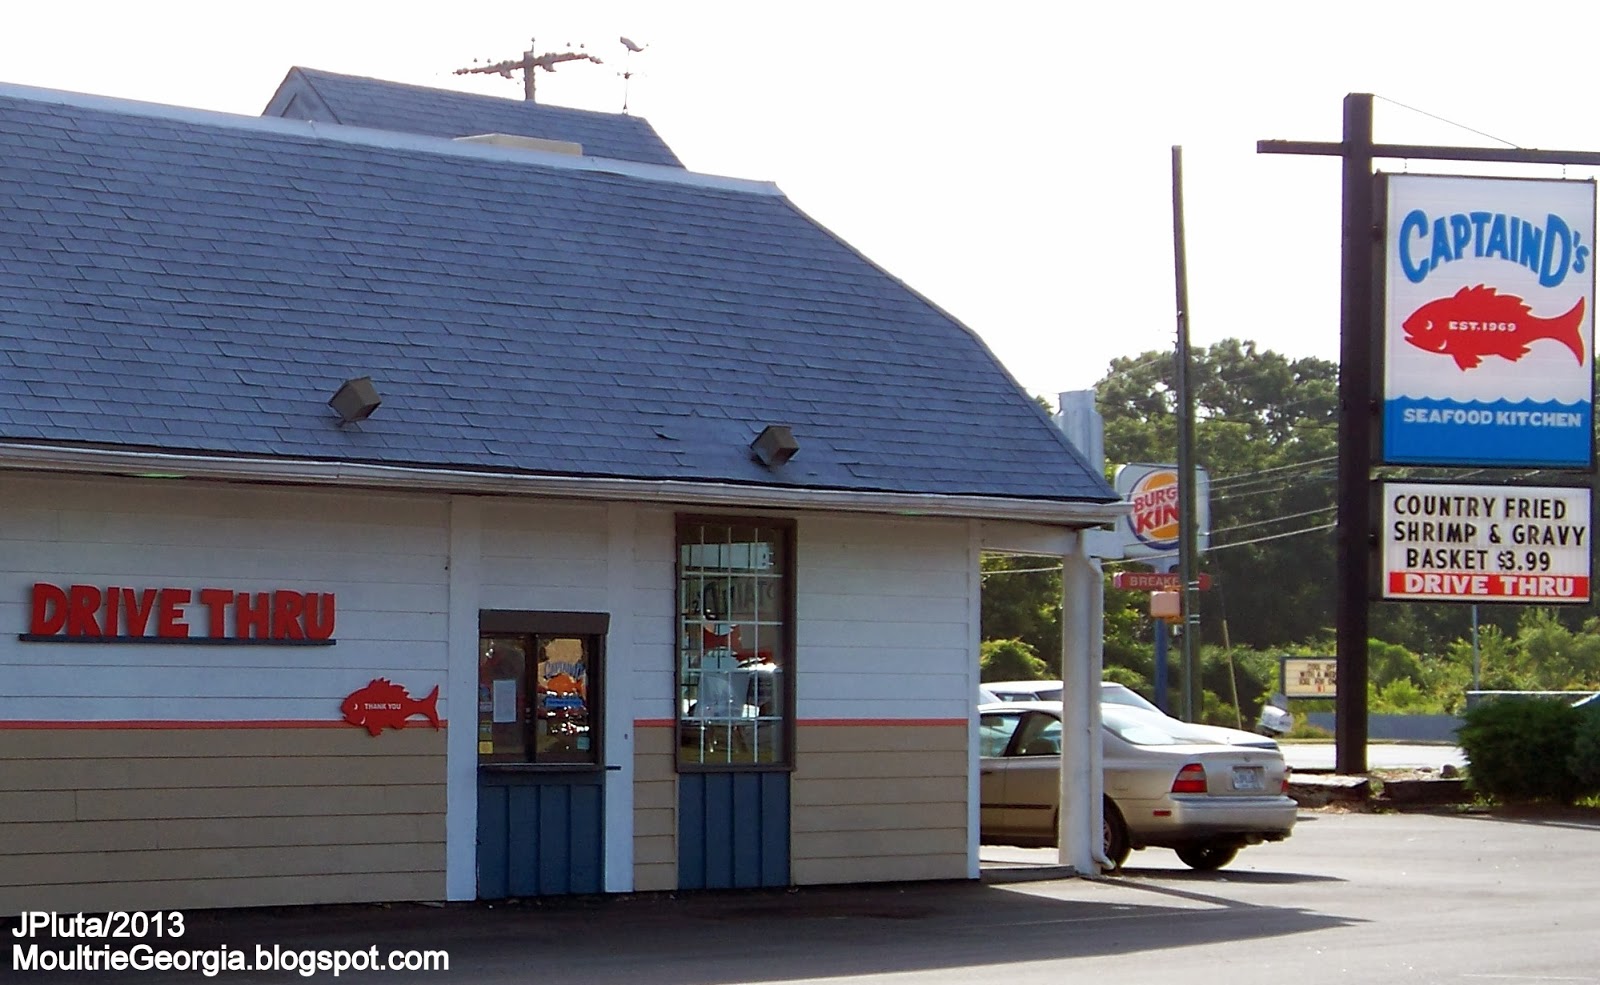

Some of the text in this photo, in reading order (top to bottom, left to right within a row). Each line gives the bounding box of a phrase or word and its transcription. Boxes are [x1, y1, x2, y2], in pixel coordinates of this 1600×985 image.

[1403, 408, 1582, 427] SEAFOOD KITCHEN
[1134, 488, 1179, 513] BURG
[1394, 495, 1566, 519] COUNTRY FRIED
[1136, 504, 1179, 536] KIN
[1394, 521, 1585, 546] SHRIMP & GRAVY
[1407, 548, 1550, 571] BASKET $3.99
[1405, 573, 1574, 597] DRIVE THRU
[31, 583, 336, 641] DRIVE THRU
